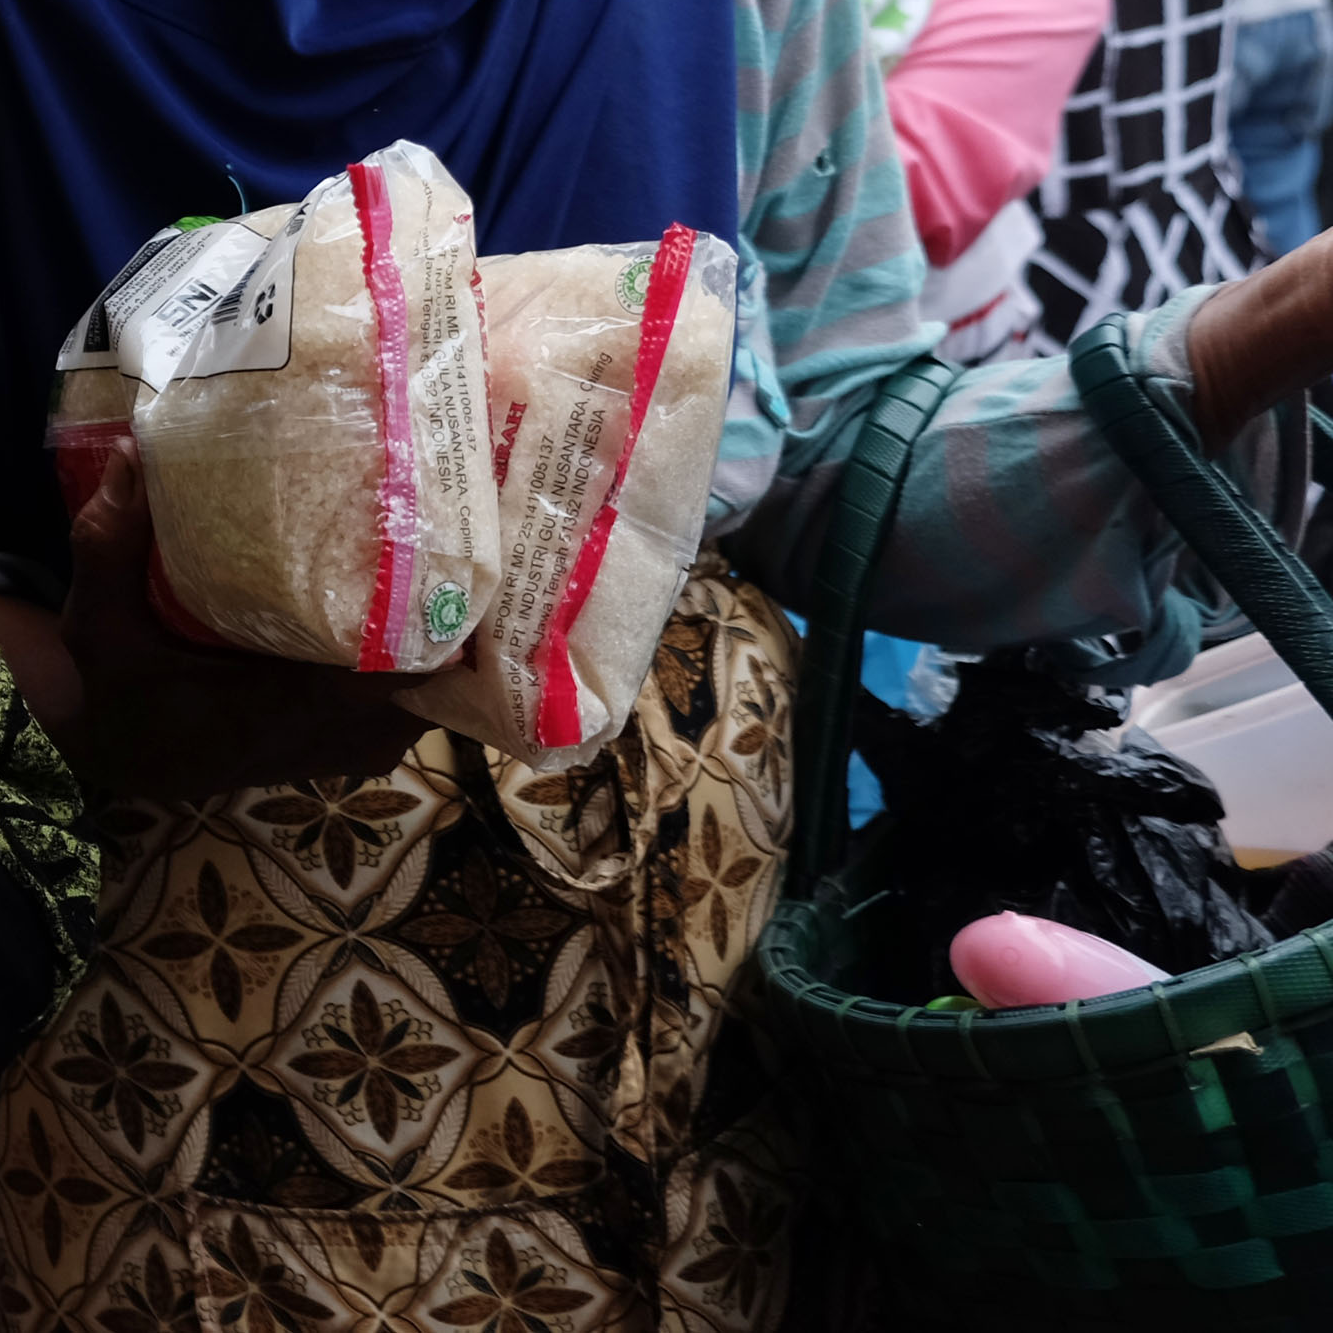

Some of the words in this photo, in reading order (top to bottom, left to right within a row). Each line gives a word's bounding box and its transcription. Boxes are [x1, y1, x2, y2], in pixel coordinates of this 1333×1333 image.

[444, 244, 460, 291] BPOM
[155, 278, 219, 327] SNI
[443, 294, 457, 312] RI
[445, 315, 460, 341] MD
[419, 296, 433, 350] Tengah
[426, 401, 453, 494] INDONESIA
[443, 394, 468, 501] NUSANTARA,
[456, 504, 477, 561] Cepirin
[515, 434, 557, 541] 251411005137
[516, 543, 550, 622] INDUSTRI
[548, 393, 592, 498] NUSANTARA,
[542, 544, 571, 600] Tengah
[568, 406, 608, 497] INDONESIA
[503, 570, 521, 589] RI
[508, 541, 528, 570] MD
[490, 590, 516, 641] BPOM
